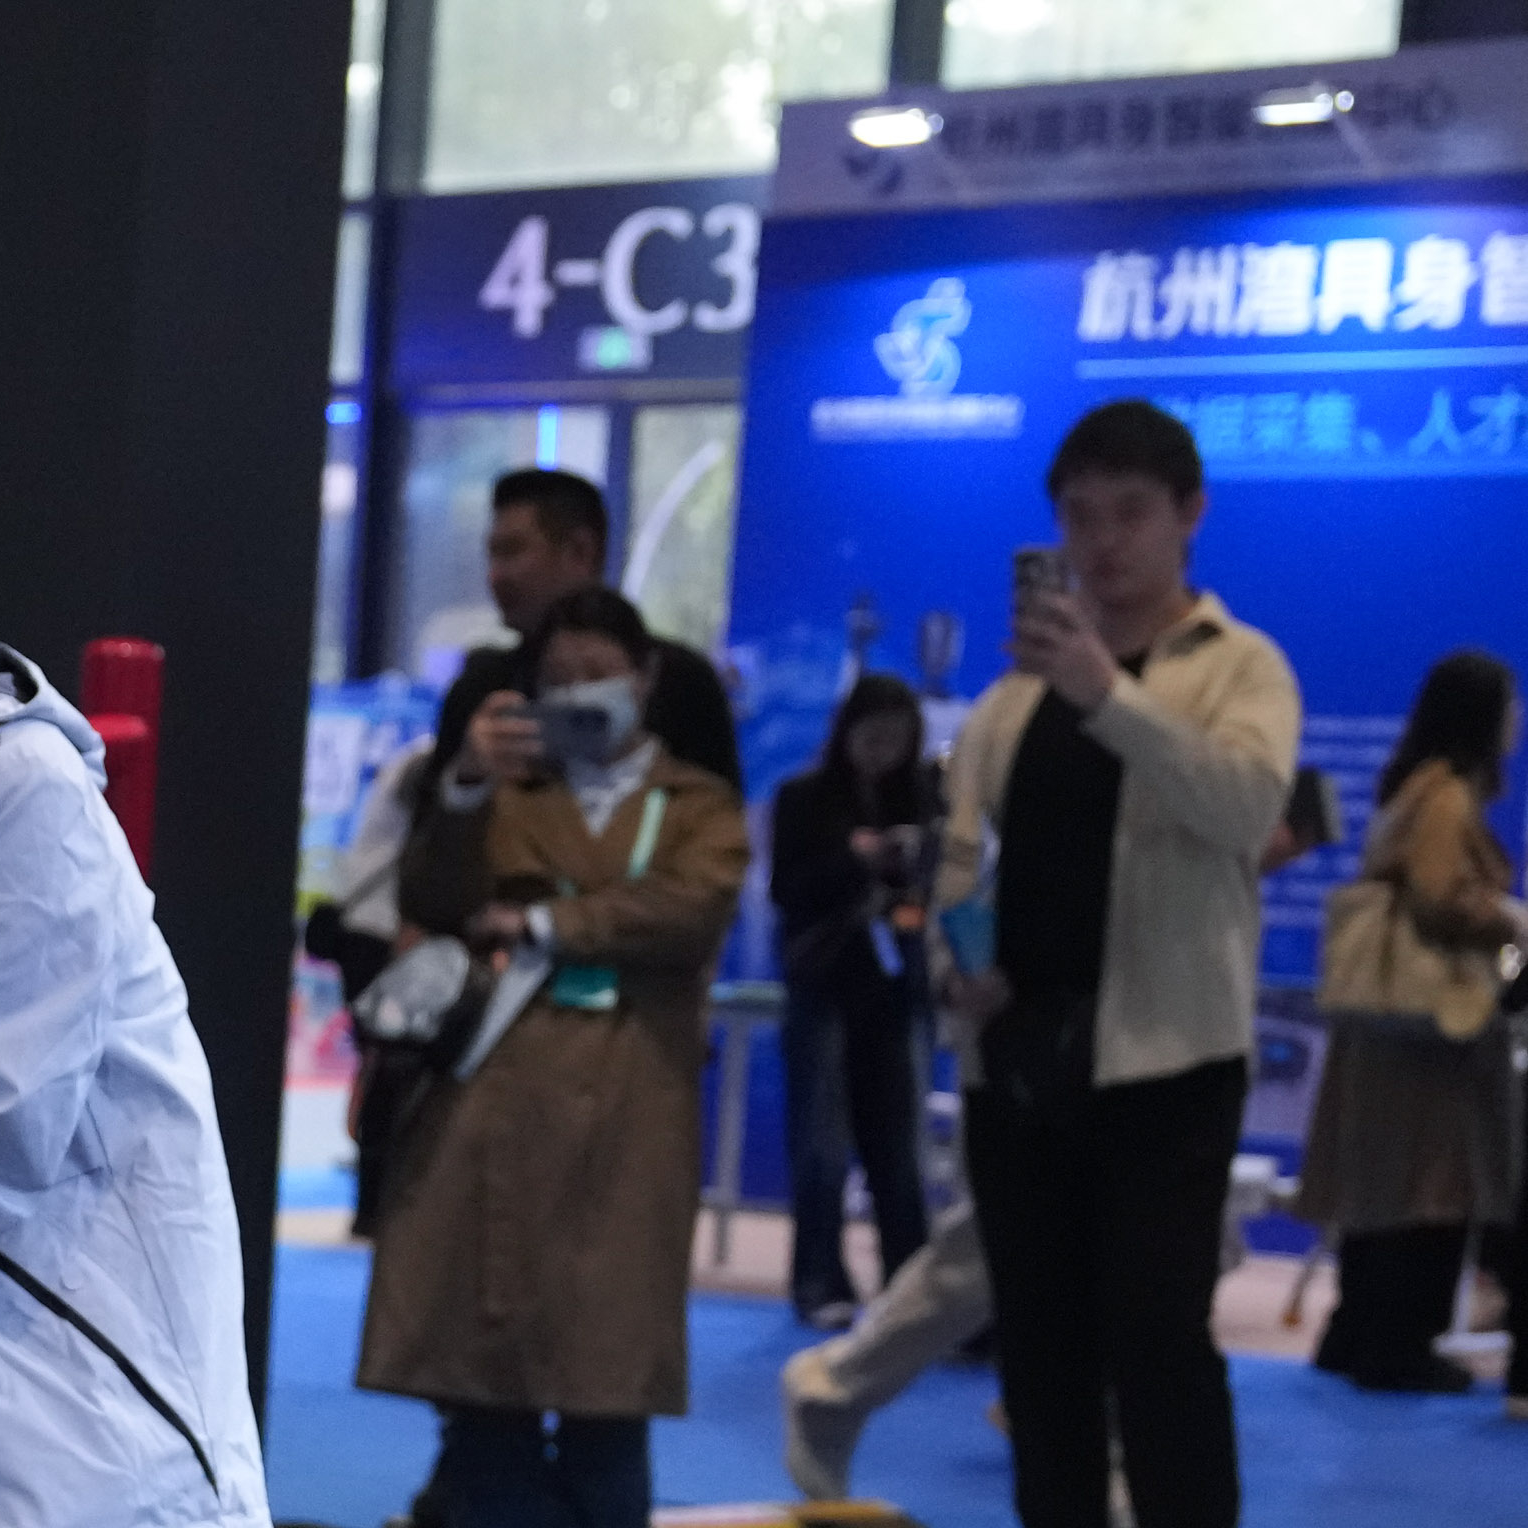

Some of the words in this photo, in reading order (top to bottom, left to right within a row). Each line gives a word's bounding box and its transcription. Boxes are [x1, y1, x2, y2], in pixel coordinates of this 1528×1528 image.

[477, 203, 763, 338] 4-C3
[1157, 384, 1528, 458] 据采集、人才
